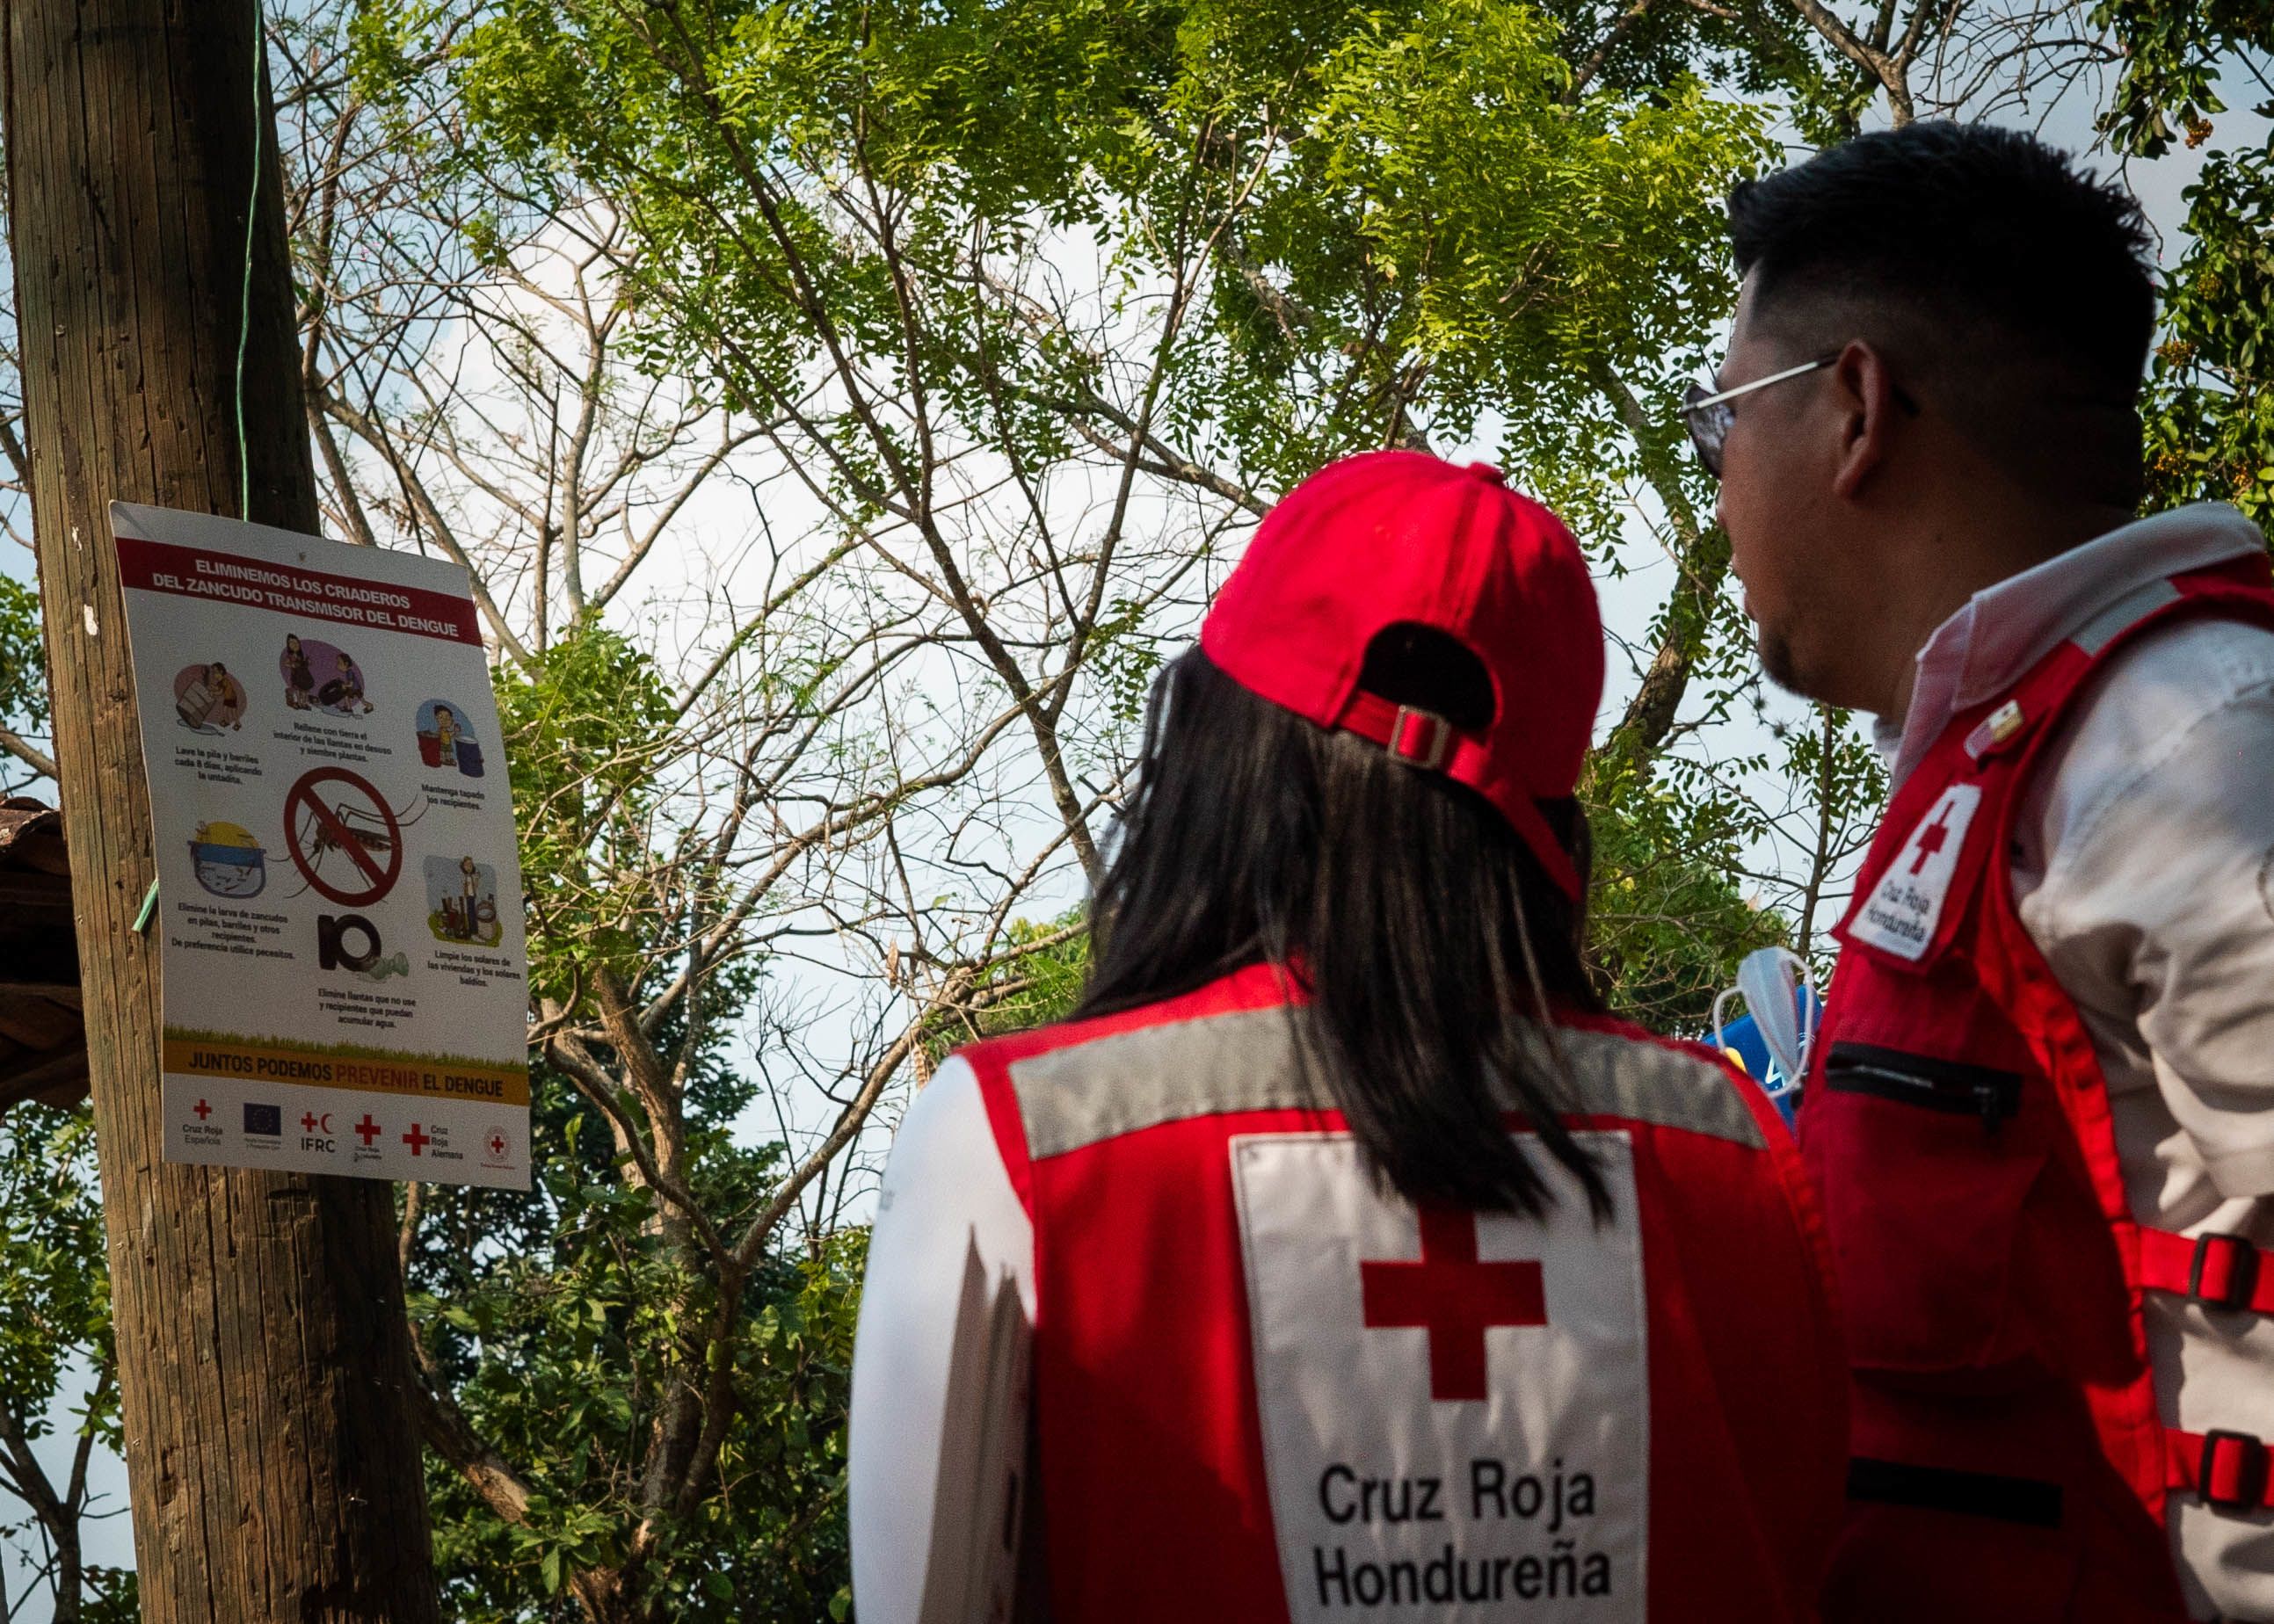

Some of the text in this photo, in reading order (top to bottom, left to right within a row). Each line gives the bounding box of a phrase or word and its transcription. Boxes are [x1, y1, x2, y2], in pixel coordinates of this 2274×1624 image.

[195, 559, 410, 609] ELIMINEMOS LOS CRIADEROS
[153, 573, 459, 637] DEL ZANCUDO TRANSMISOR DEL DENGUE
[323, 728, 338, 736] con
[176, 746, 195, 755] Lave
[197, 748, 205, 757] la
[207, 750, 222, 759] pila
[302, 735, 312, 743] de
[314, 736, 325, 746] las
[326, 737, 352, 749] llantas
[365, 743, 392, 755] desuso
[175, 758, 194, 767] cada
[225, 764, 262, 775] aplicando
[198, 771, 207, 780] la
[422, 783, 458, 797] Mantenga
[427, 794, 438, 804] los
[178, 903, 288, 924] Elimine la larva de zancudos
[200, 917, 220, 930] pilas,
[222, 919, 251, 931] barriles
[253, 924, 258, 933] y
[260, 924, 280, 934] otros
[171, 938, 183, 947] De
[185, 939, 229, 953] preferencia
[230, 945, 254, 955] utilice
[435, 950, 511, 967] Limpie los solares de
[427, 961, 521, 980] las viviendas y los solares
[318, 988, 346, 999] Elimine
[347, 991, 374, 1002] llantas
[374, 995, 389, 1004] que
[390, 997, 401, 1005] no
[319, 1003, 323, 1011] y
[325, 1002, 367, 1013] recipientes
[369, 1007, 383, 1016] que
[338, 1016, 374, 1026] acumular
[189, 1052, 504, 1098] JUNTOS PODEMOS PREVENIR EL DENGUE
[182, 1124, 223, 1136] Cruz Roja
[431, 1125, 448, 1135] Cruz
[185, 1135, 222, 1145] Española
[301, 1136, 336, 1153] IFRC
[432, 1137, 448, 1148] Roja
[431, 1149, 464, 1161] Alemana
[1319, 1457, 1595, 1533] Cruz Roja
[1312, 1540, 1612, 1606] Hondureña
